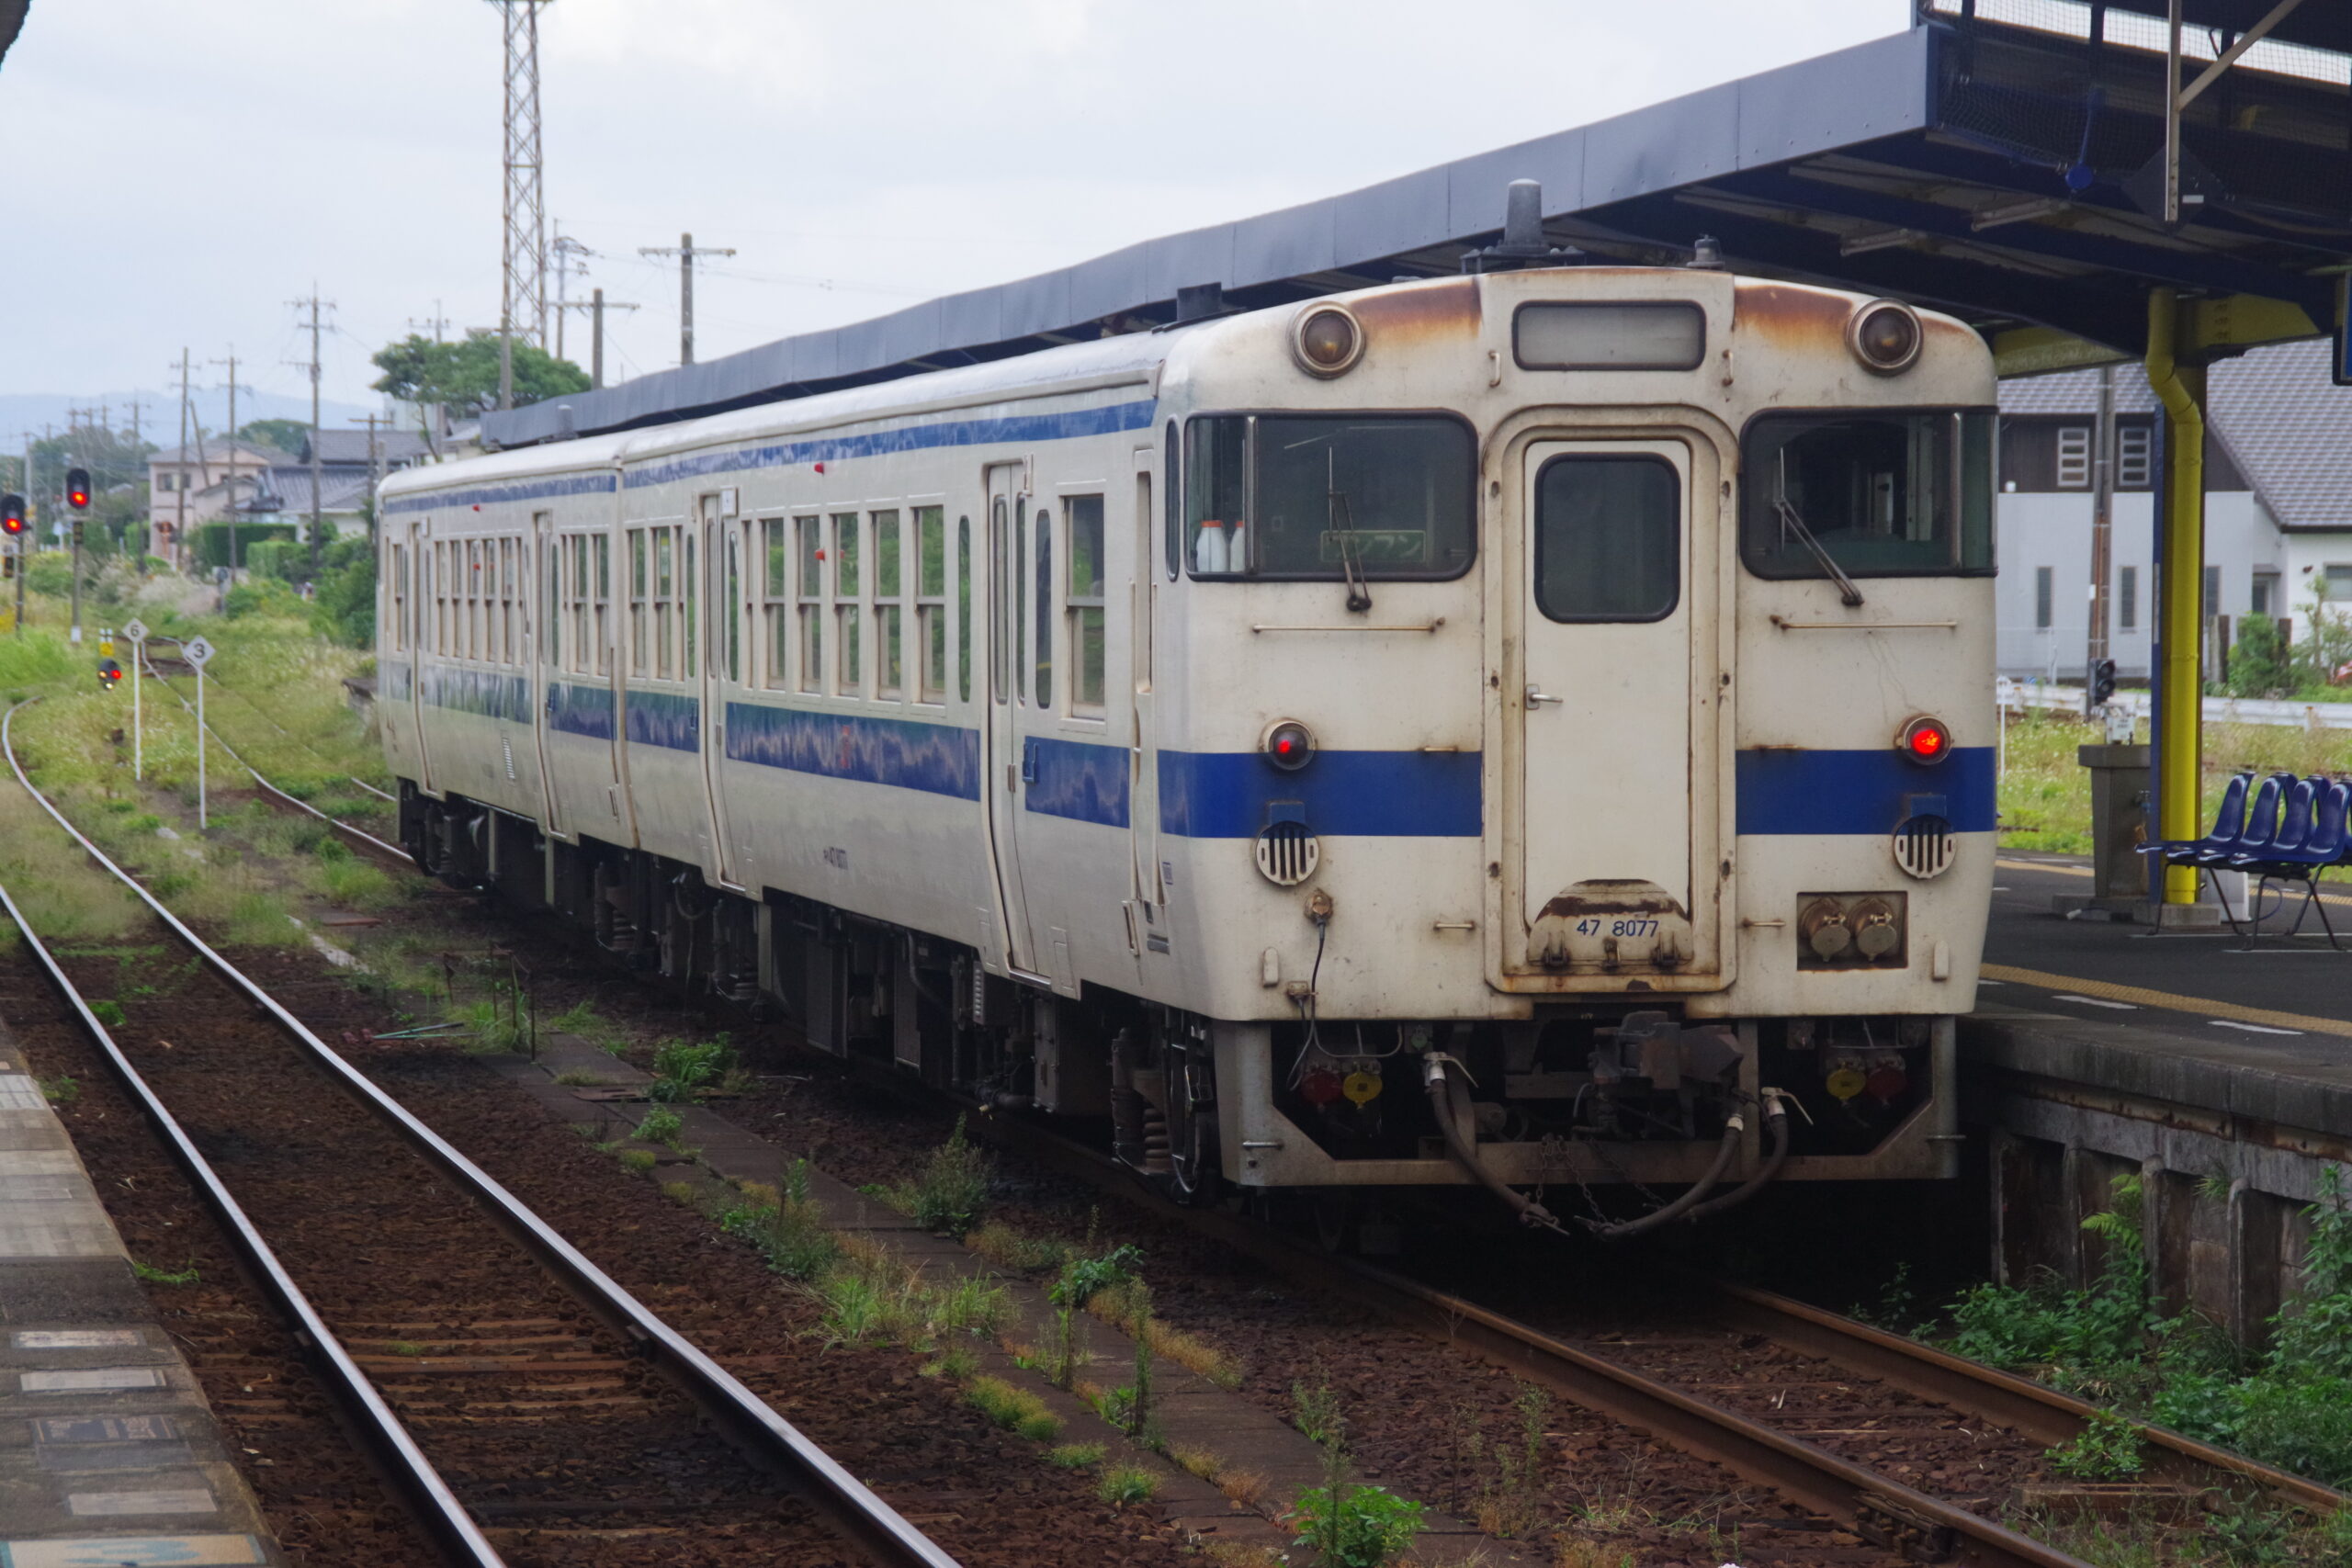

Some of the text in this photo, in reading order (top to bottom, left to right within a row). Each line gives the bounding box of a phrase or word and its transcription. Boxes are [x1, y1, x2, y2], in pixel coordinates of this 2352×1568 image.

[130, 625, 140, 637] 6
[193, 643, 205, 659] 3
[1576, 919, 1659, 938] 47 8077
